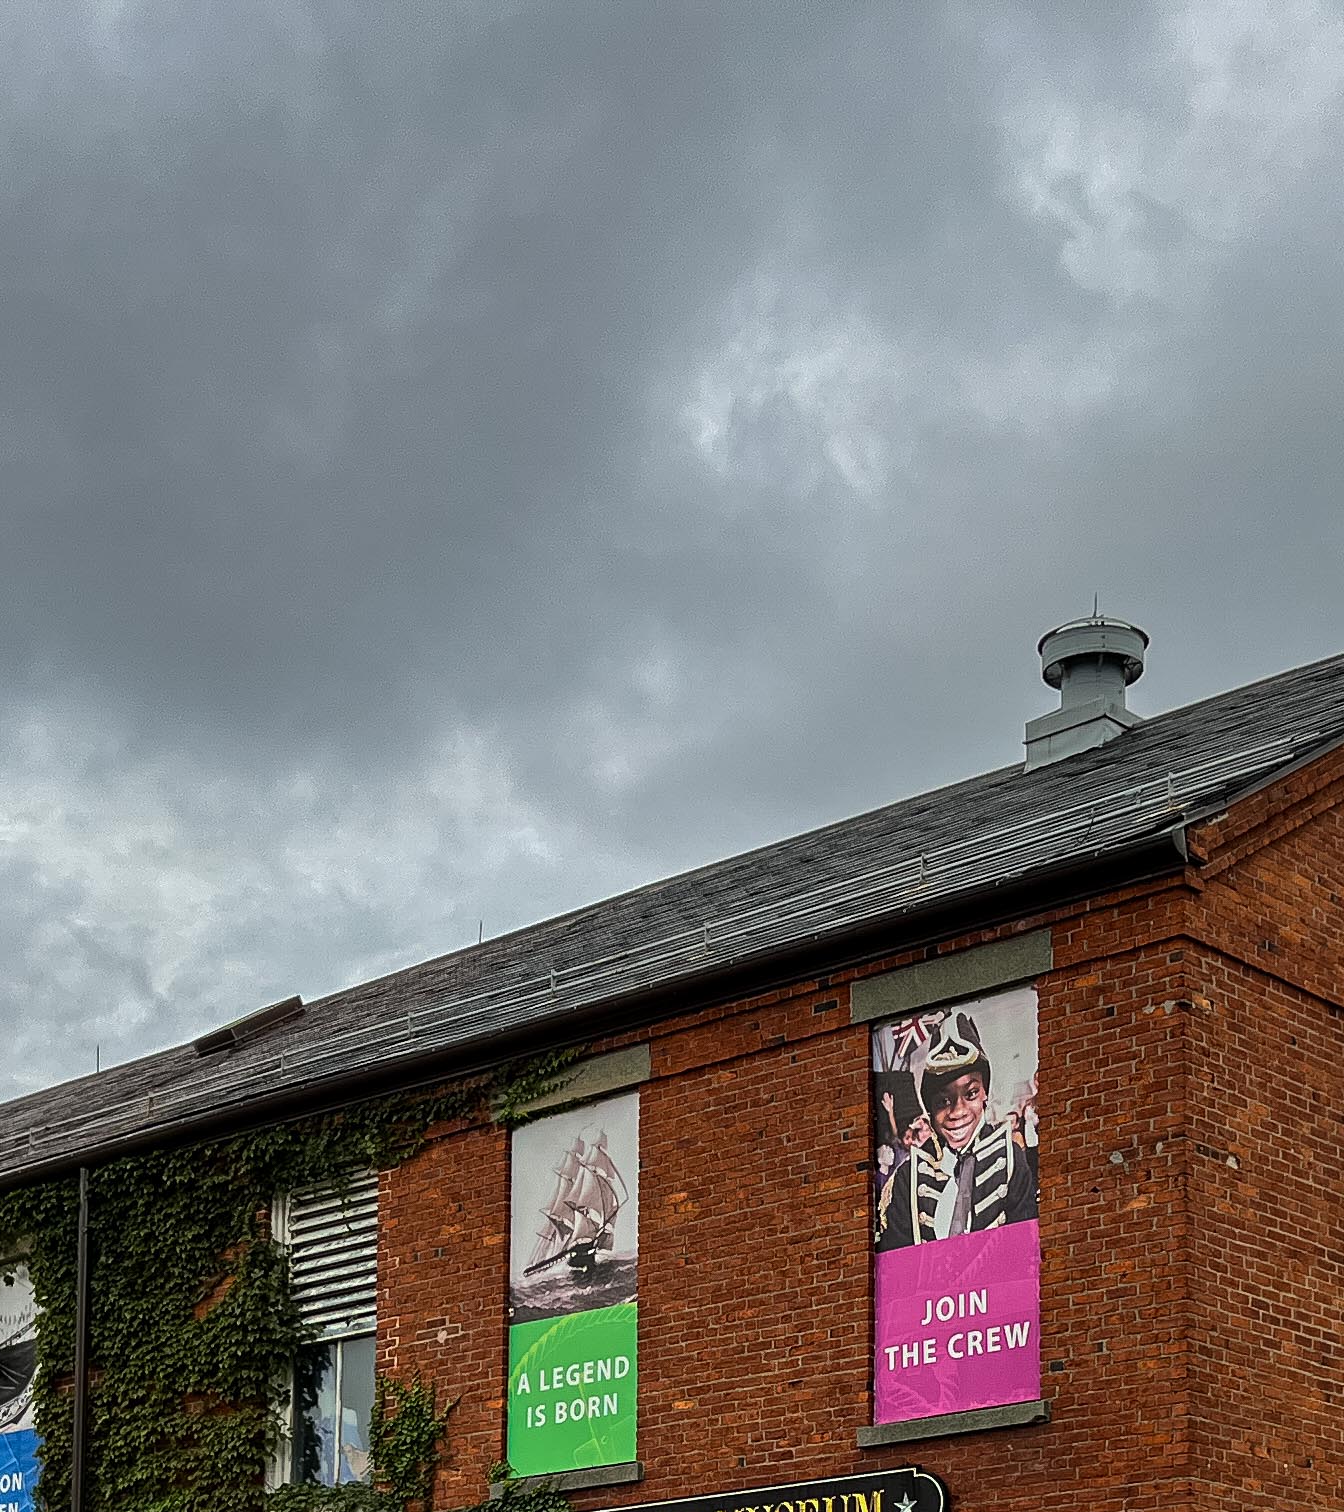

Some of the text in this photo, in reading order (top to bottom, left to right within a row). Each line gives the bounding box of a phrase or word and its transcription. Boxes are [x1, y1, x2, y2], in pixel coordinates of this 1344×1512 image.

[921, 1288, 988, 1326] JOIN
[884, 1320, 1031, 1371] THE CREW
[516, 1355, 630, 1396] A LEGEND
[527, 1392, 618, 1428] IS BORN
